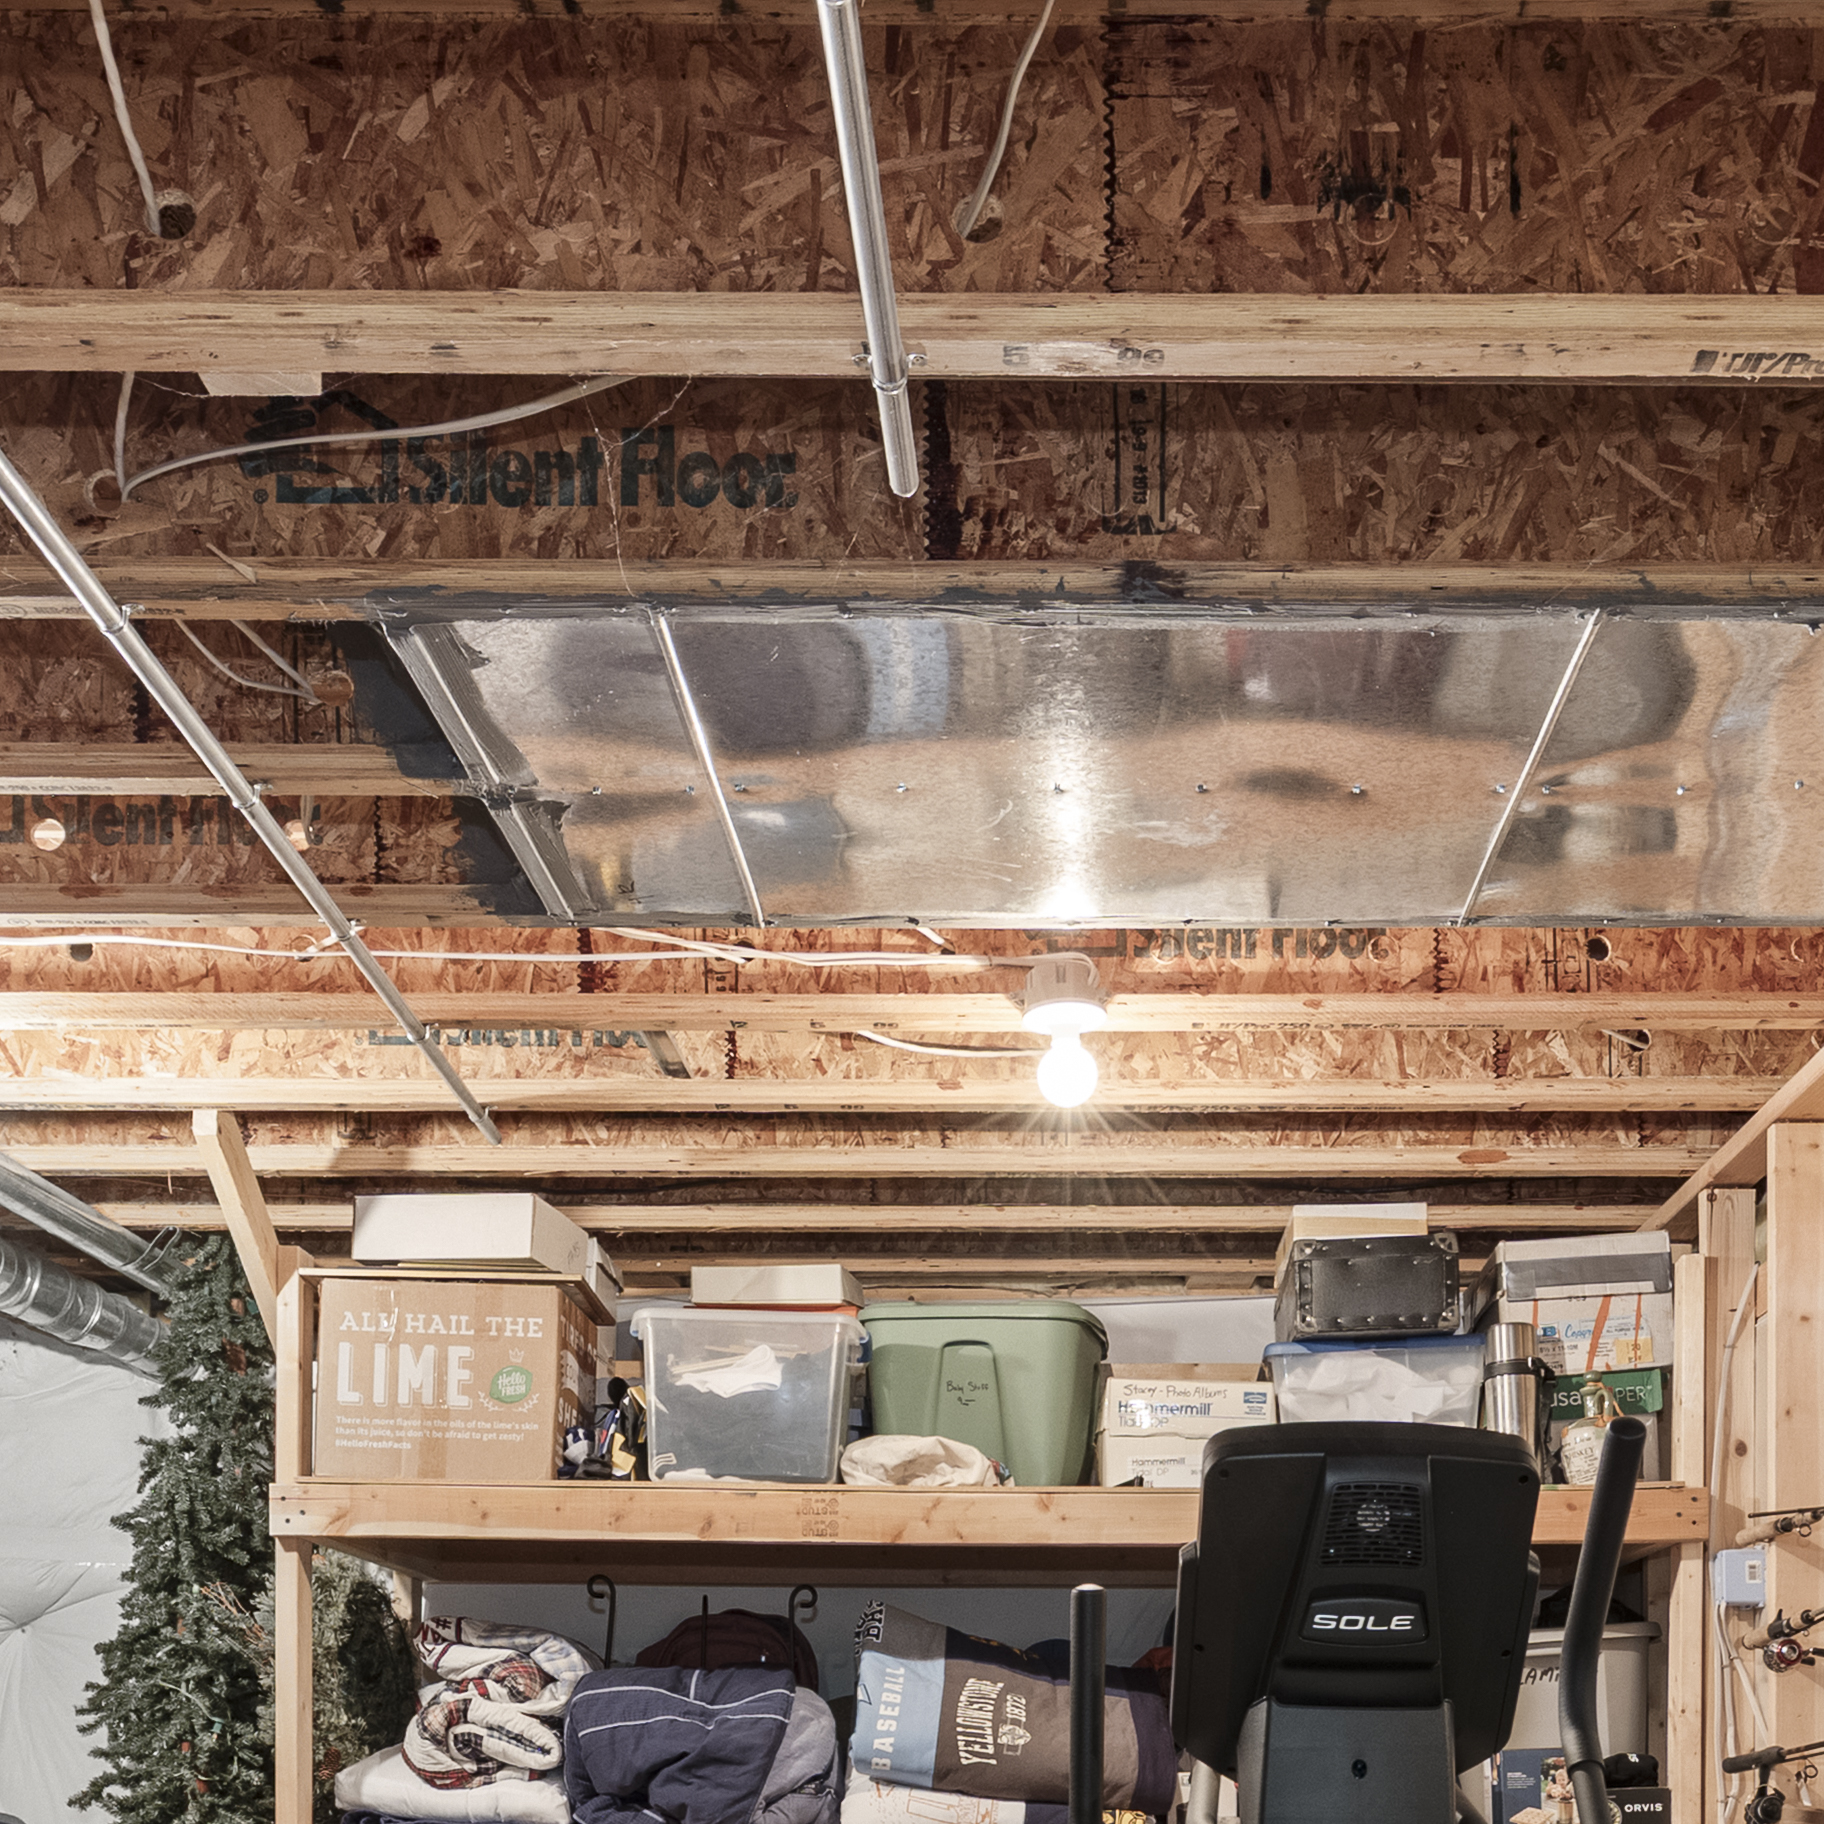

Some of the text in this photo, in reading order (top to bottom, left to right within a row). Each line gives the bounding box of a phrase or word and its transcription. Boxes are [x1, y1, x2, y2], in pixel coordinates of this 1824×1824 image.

[410, 425, 799, 510] Silent Floor
[338, 1311, 543, 1338] ALL HAIL THE
[336, 1340, 475, 1411] LIME
[497, 1374, 526, 1389] Hello
[501, 1385, 526, 1397] FRESH
[1166, 1384, 1192, 1398] Photo
[1192, 1386, 1229, 1399] Albums
[335, 1416, 539, 1432] There is more flavor in the oils of the lime's skin
[335, 1427, 355, 1436] than
[357, 1427, 368, 1436] its
[370, 1427, 393, 1439] juice,
[406, 1429, 430, 1438] don't
[433, 1430, 443, 1439] be
[445, 1431, 470, 1440] afraid
[471, 1432, 480, 1441] to
[482, 1433, 497, 1444] get
[498, 1432, 524, 1445] zesty!
[1132, 1457, 1186, 1467] Hammermill
[1312, 1614, 1416, 1632] SOLE
[871, 1665, 905, 1773] BASEBALL
[959, 1678, 1005, 1767] YELLOWSTONE
[1624, 1803, 1664, 1812] ORVIS
